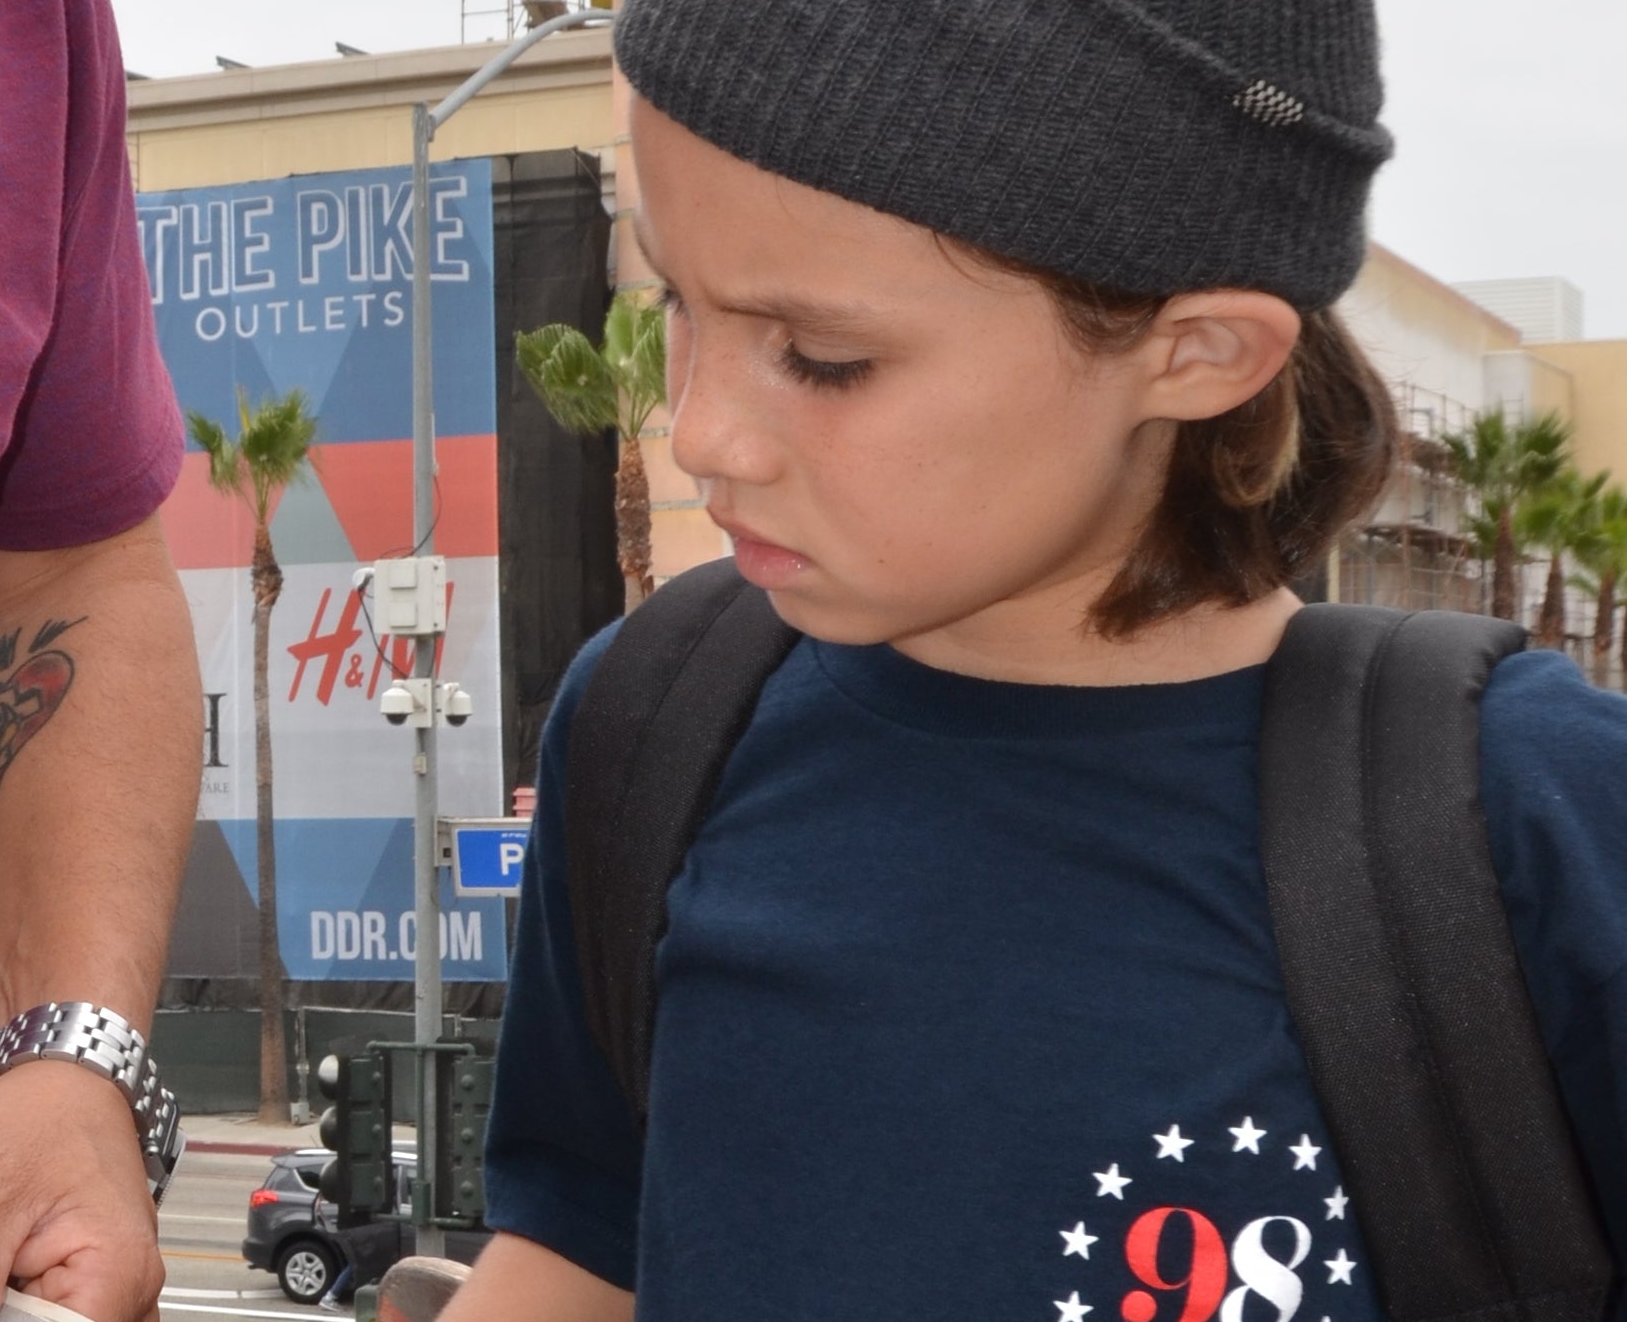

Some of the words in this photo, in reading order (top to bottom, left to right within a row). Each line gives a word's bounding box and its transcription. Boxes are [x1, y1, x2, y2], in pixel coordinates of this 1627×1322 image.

[136, 195, 275, 306] THE
[297, 175, 470, 285] PIKE
[195, 290, 405, 341] OUTLETS
